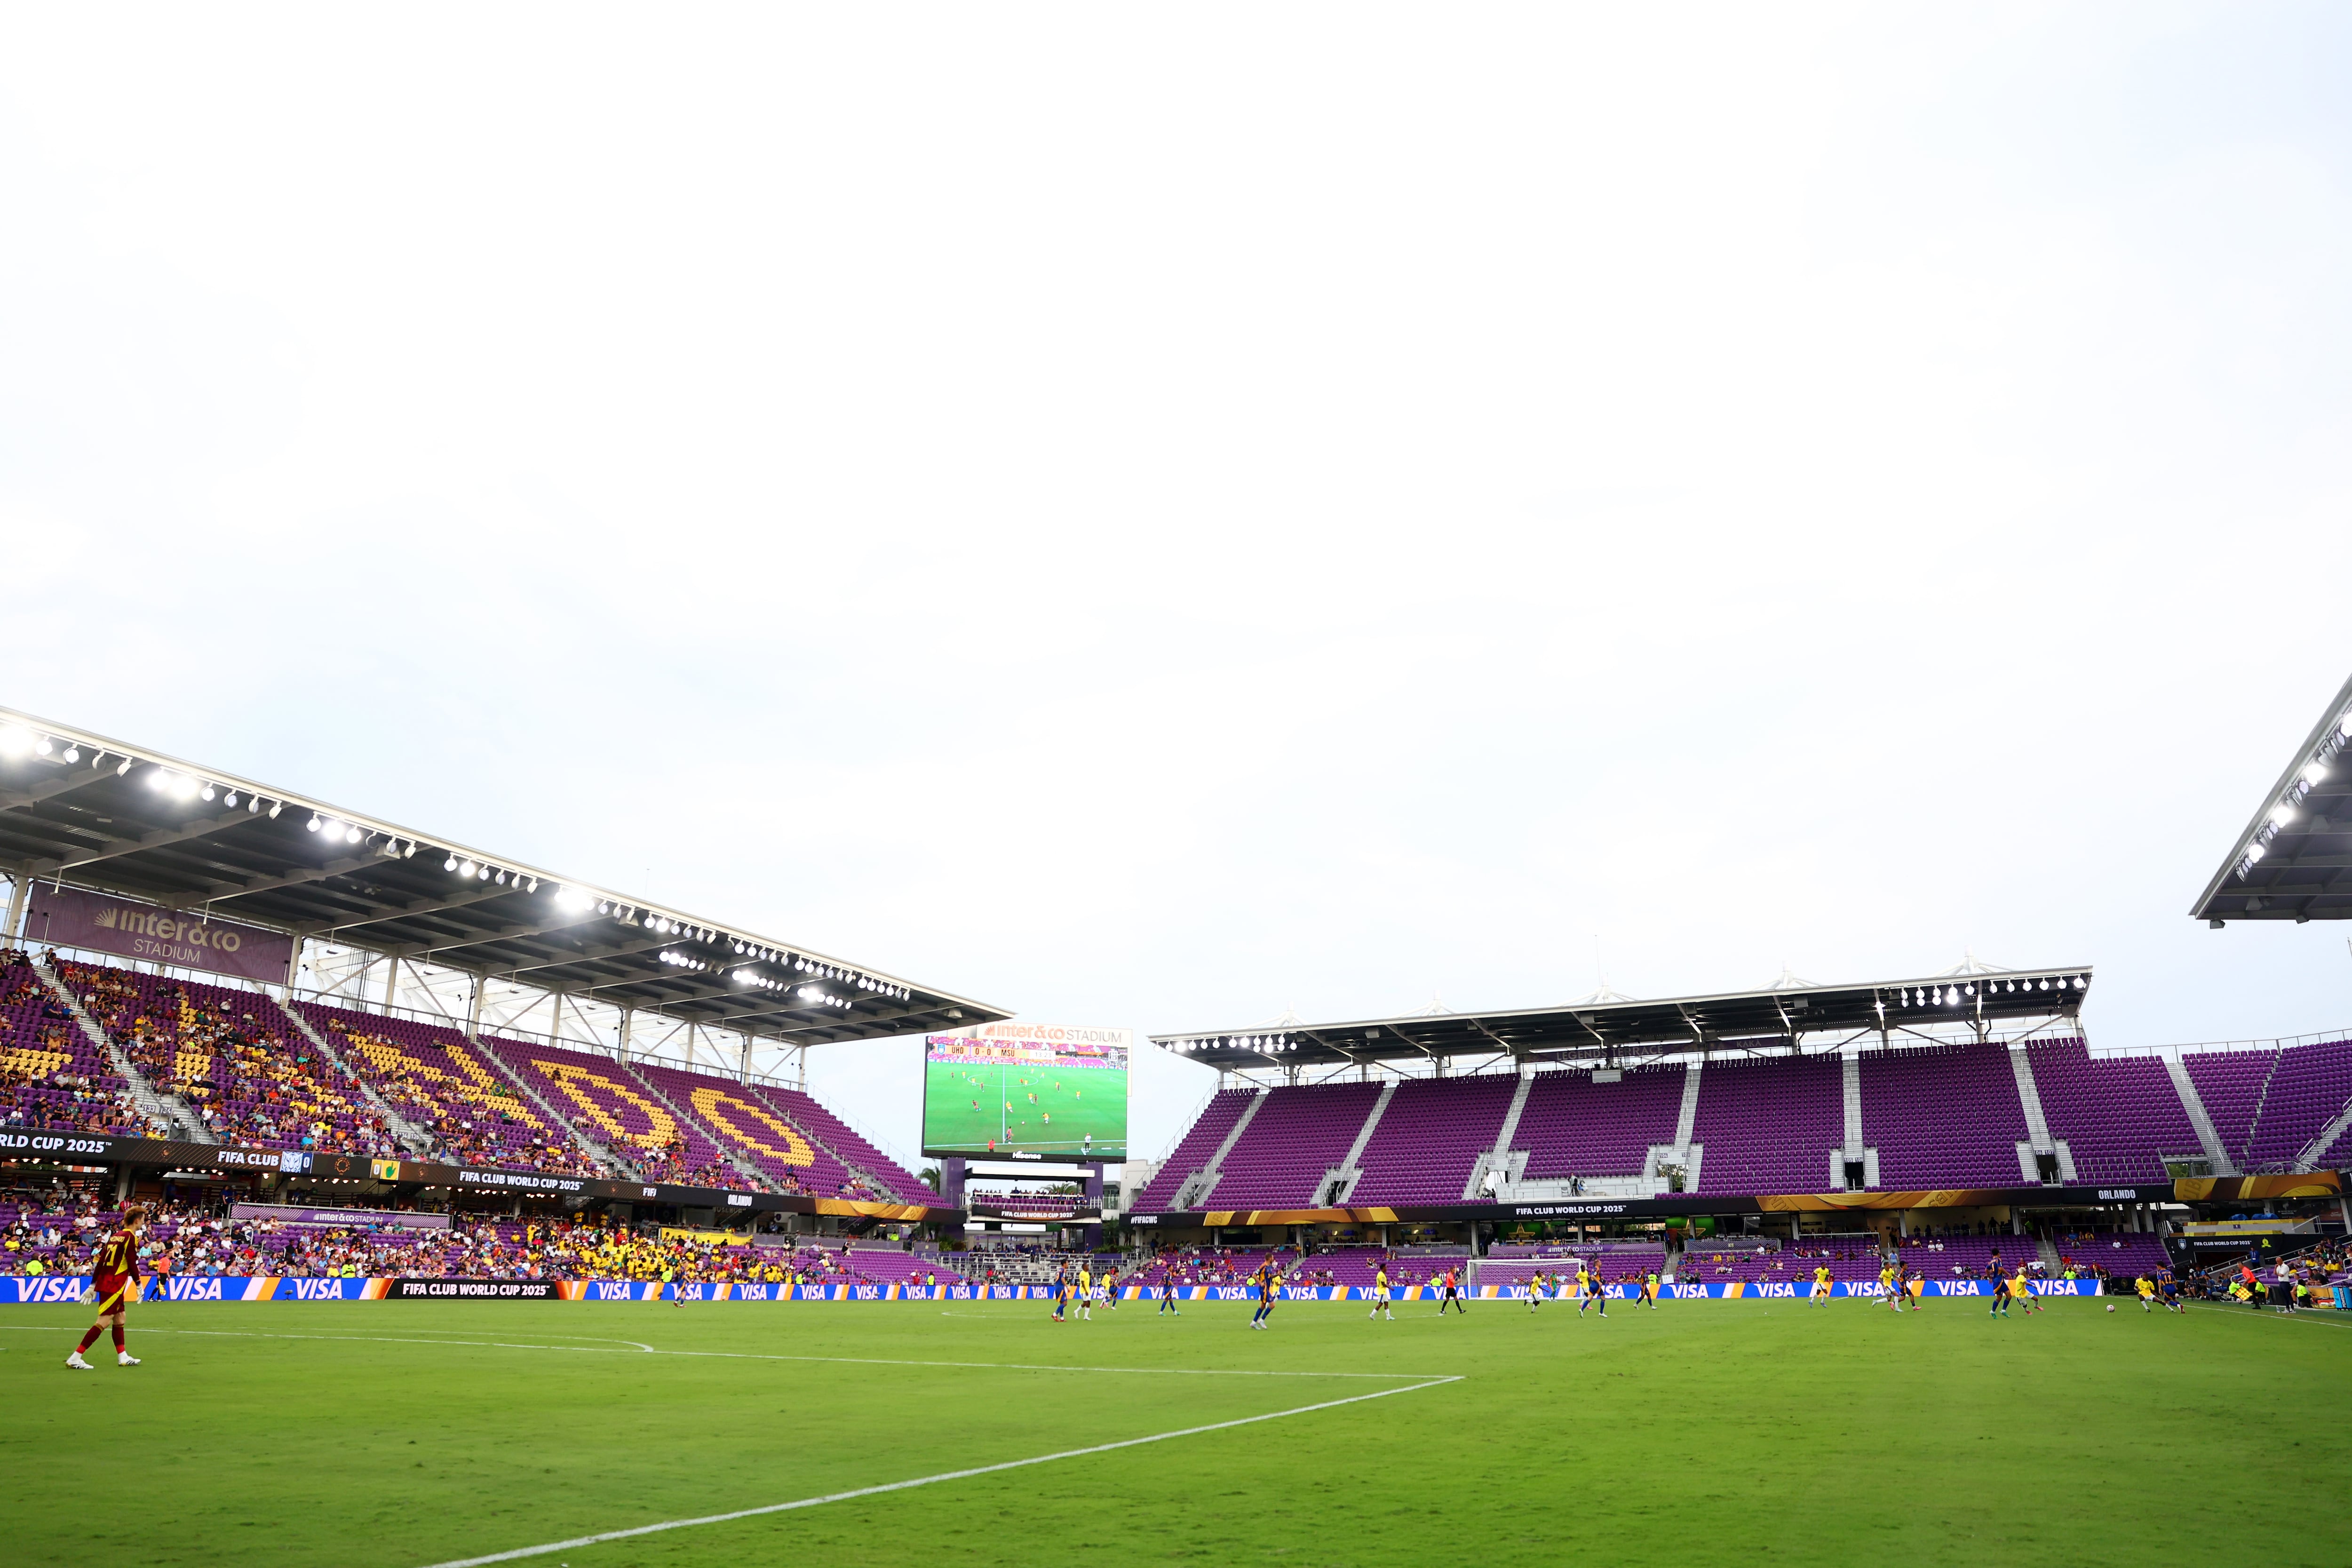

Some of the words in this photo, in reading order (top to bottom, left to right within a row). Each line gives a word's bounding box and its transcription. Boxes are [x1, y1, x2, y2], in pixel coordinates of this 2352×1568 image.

[134, 939, 201, 963] STADIUM
[1066, 1029, 1122, 1043] STADIUM
[32, 1137, 64, 1150] CUP
[218, 1151, 245, 1164] FIFA
[247, 1153, 279, 1166] CLUB
[1012, 1151, 1041, 1160] Hisense
[459, 1171, 480, 1182] FIFA
[482, 1173, 505, 1185] CLUB
[507, 1175, 540, 1188] WORLD
[540, 1178, 558, 1189] CUP
[727, 1194, 753, 1207] ORLANDO
[2098, 1189, 2136, 1199] ORLANDO
[1555, 1206, 1584, 1214] WORLD
[1130, 1216, 1158, 1224] #FIFACWC
[12, 1278, 81, 1302] VISA
[169, 1277, 222, 1300] VISA
[292, 1278, 342, 1299] VISA
[403, 1283, 427, 1295] FIFA
[429, 1283, 457, 1295] CLUB
[460, 1284, 497, 1296] WORLD
[499, 1284, 520, 1296] CUP
[596, 1282, 631, 1299] VISA
[739, 1284, 767, 1300] VISA
[800, 1285, 826, 1300] VISA
[854, 1285, 878, 1300] VISA
[905, 1286, 926, 1299] VISA
[950, 1286, 971, 1299] VISA
[992, 1286, 1011, 1299] VISA
[1031, 1286, 1048, 1299] VISA
[1216, 1287, 1248, 1300] VISA
[1284, 1287, 1319, 1300] VISA
[1669, 1284, 1708, 1298] VISA
[1754, 1283, 1796, 1297] VISA
[1842, 1282, 1885, 1297] VISA
[1933, 1281, 1979, 1296] VISA
[2030, 1280, 2077, 1295] VISA
